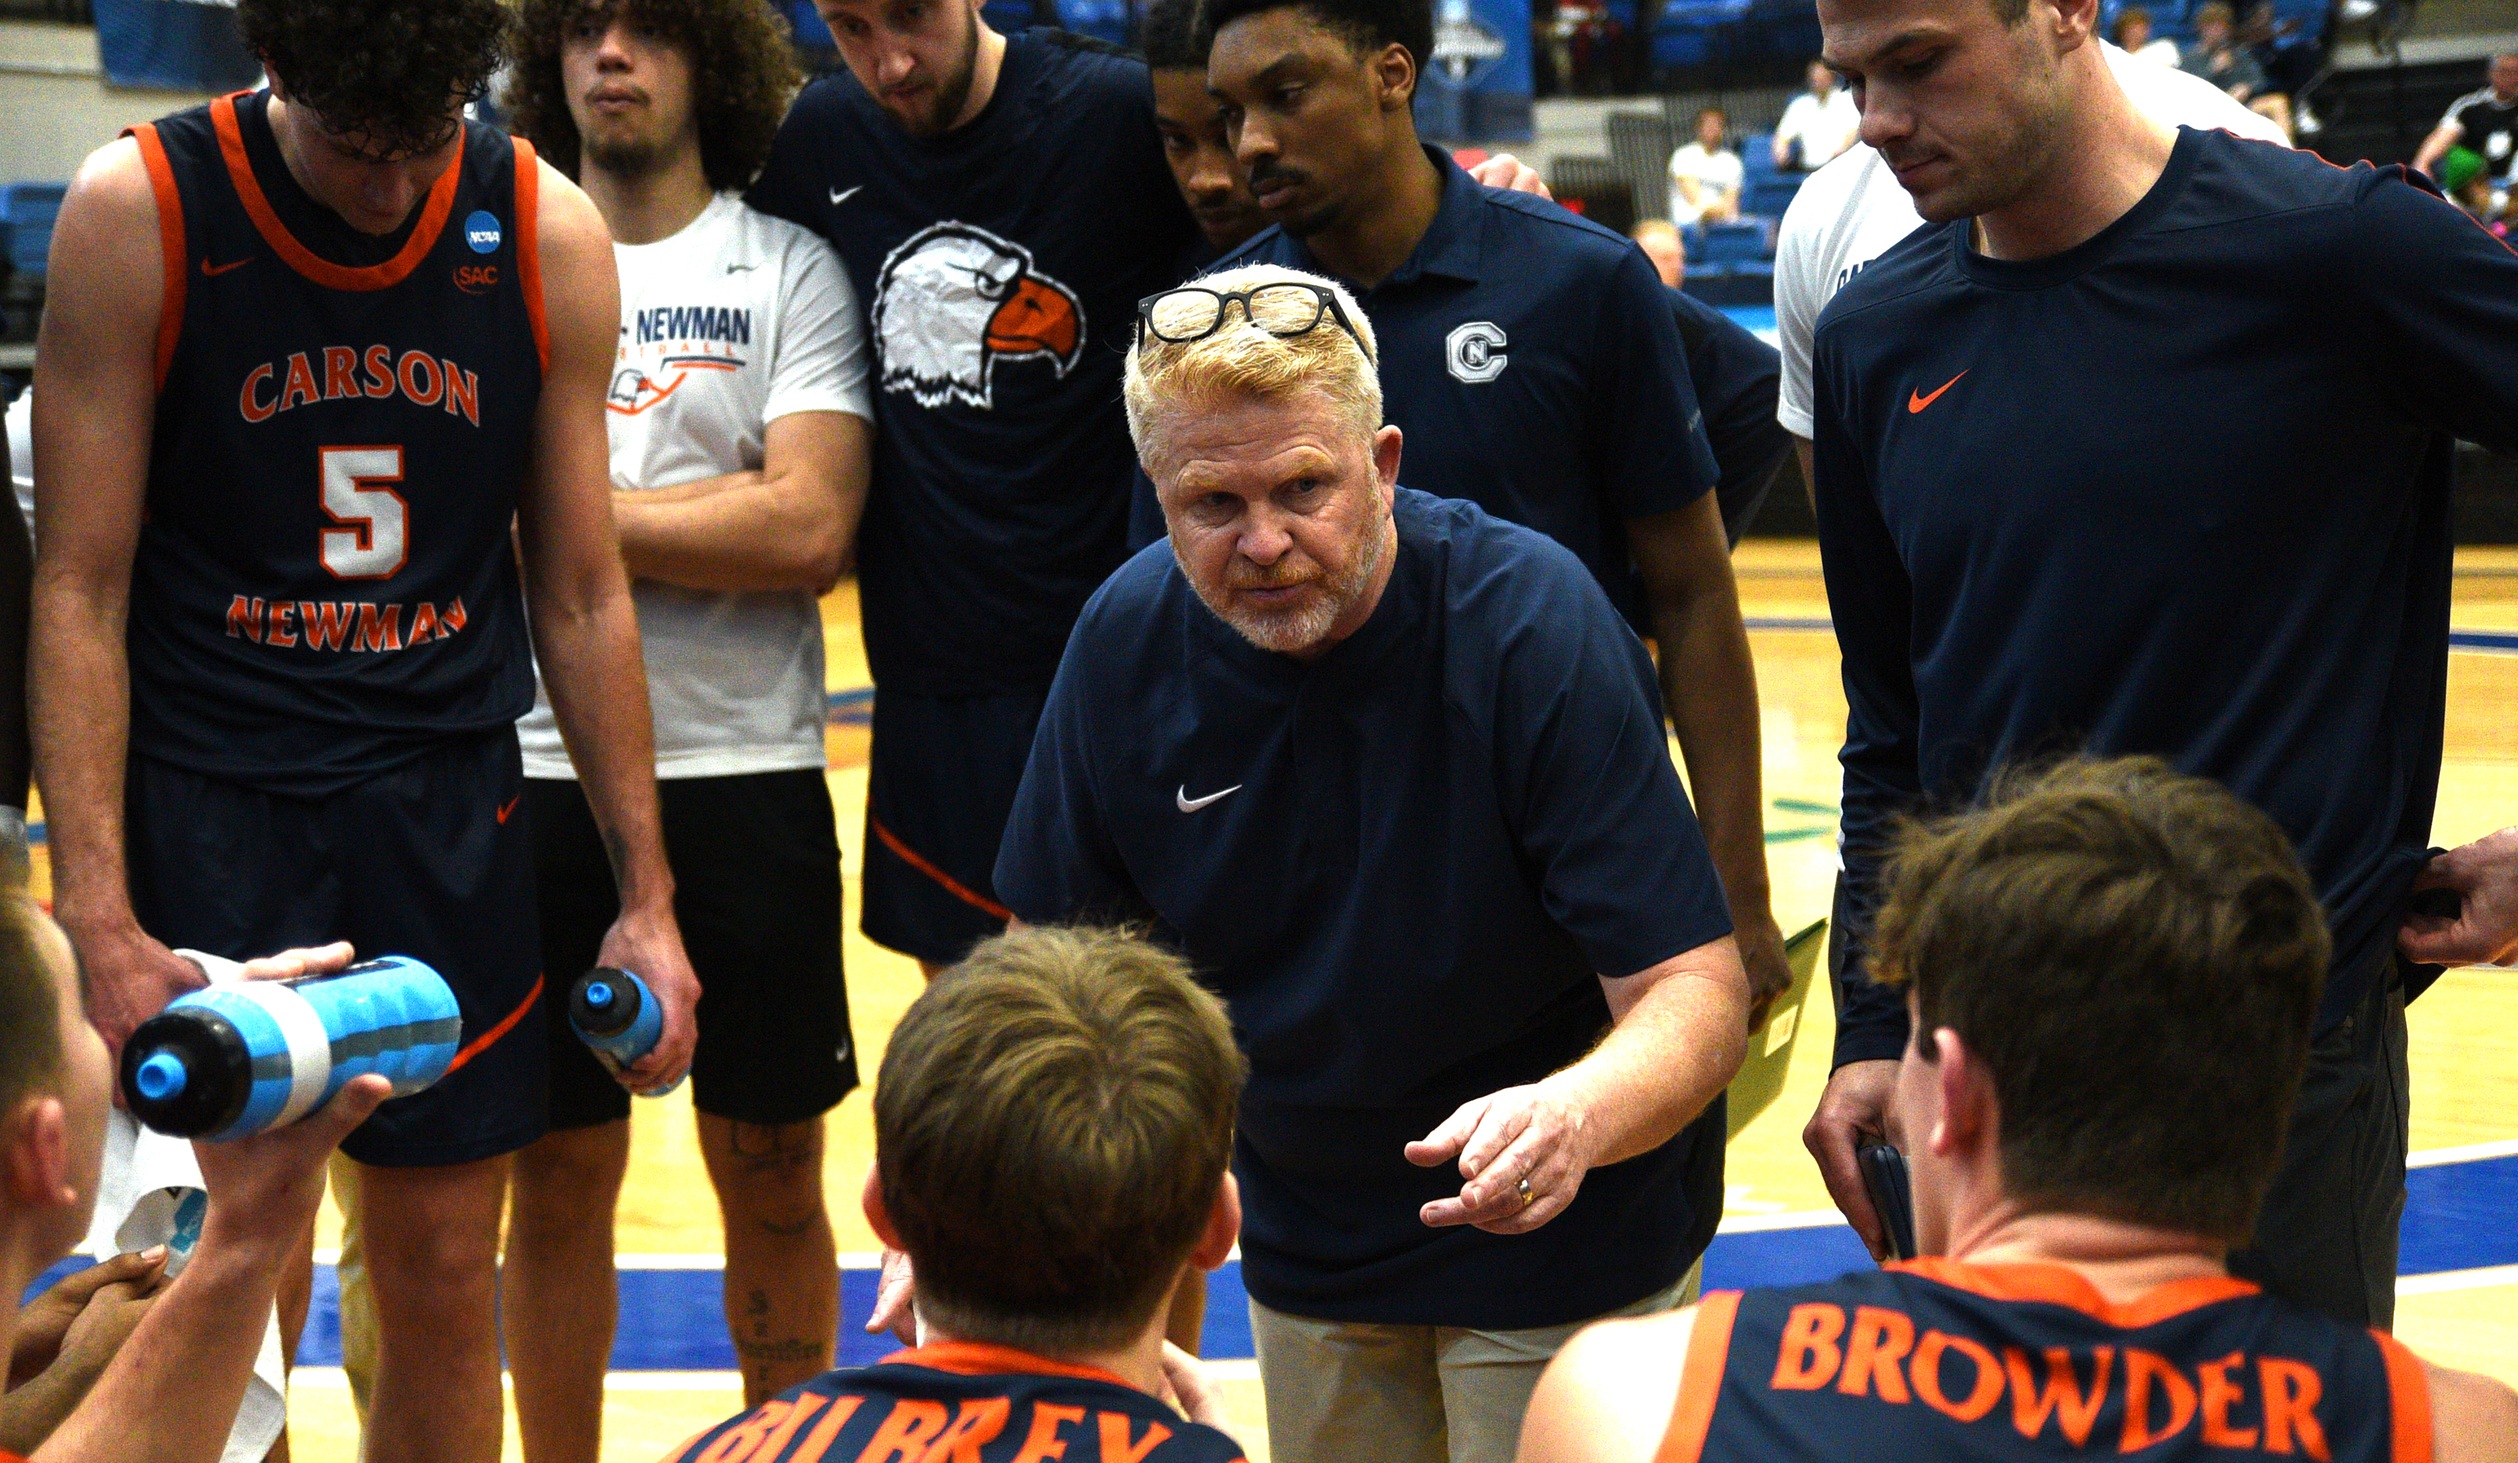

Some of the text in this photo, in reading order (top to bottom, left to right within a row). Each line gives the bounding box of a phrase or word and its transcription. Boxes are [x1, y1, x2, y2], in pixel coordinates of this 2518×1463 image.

[469, 231, 500, 243] NCAA
[459, 265, 498, 285] SAC
[239, 344, 480, 427] CARSON
[318, 444, 409, 581] 5
[226, 594, 467, 653] NEWMAN
[1771, 1302, 2332, 1461] BROWDER
